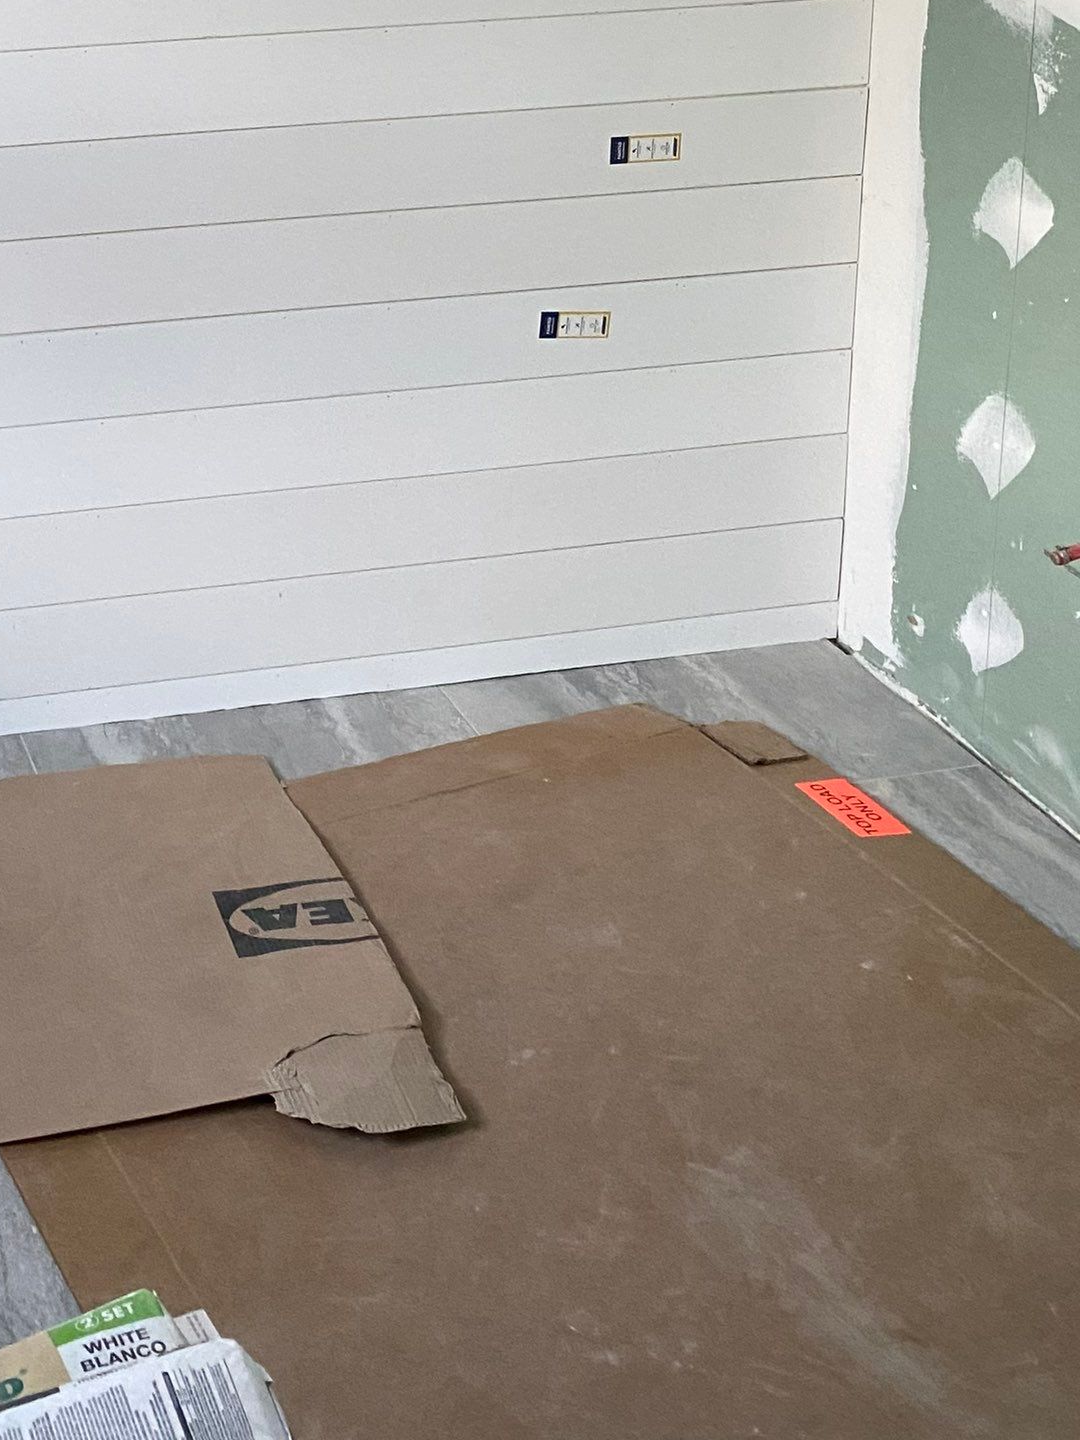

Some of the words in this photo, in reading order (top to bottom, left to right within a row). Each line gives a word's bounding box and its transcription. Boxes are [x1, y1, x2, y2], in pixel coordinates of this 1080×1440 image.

[809, 783, 852, 812] LOAD
[841, 794, 882, 821] ONLY
[847, 813, 880, 835] TOP
[241, 897, 367, 931] EA
[101, 1301, 135, 1322] SET
[82, 1327, 151, 1354] WHITE
[80, 1340, 167, 1373] BLANCO
